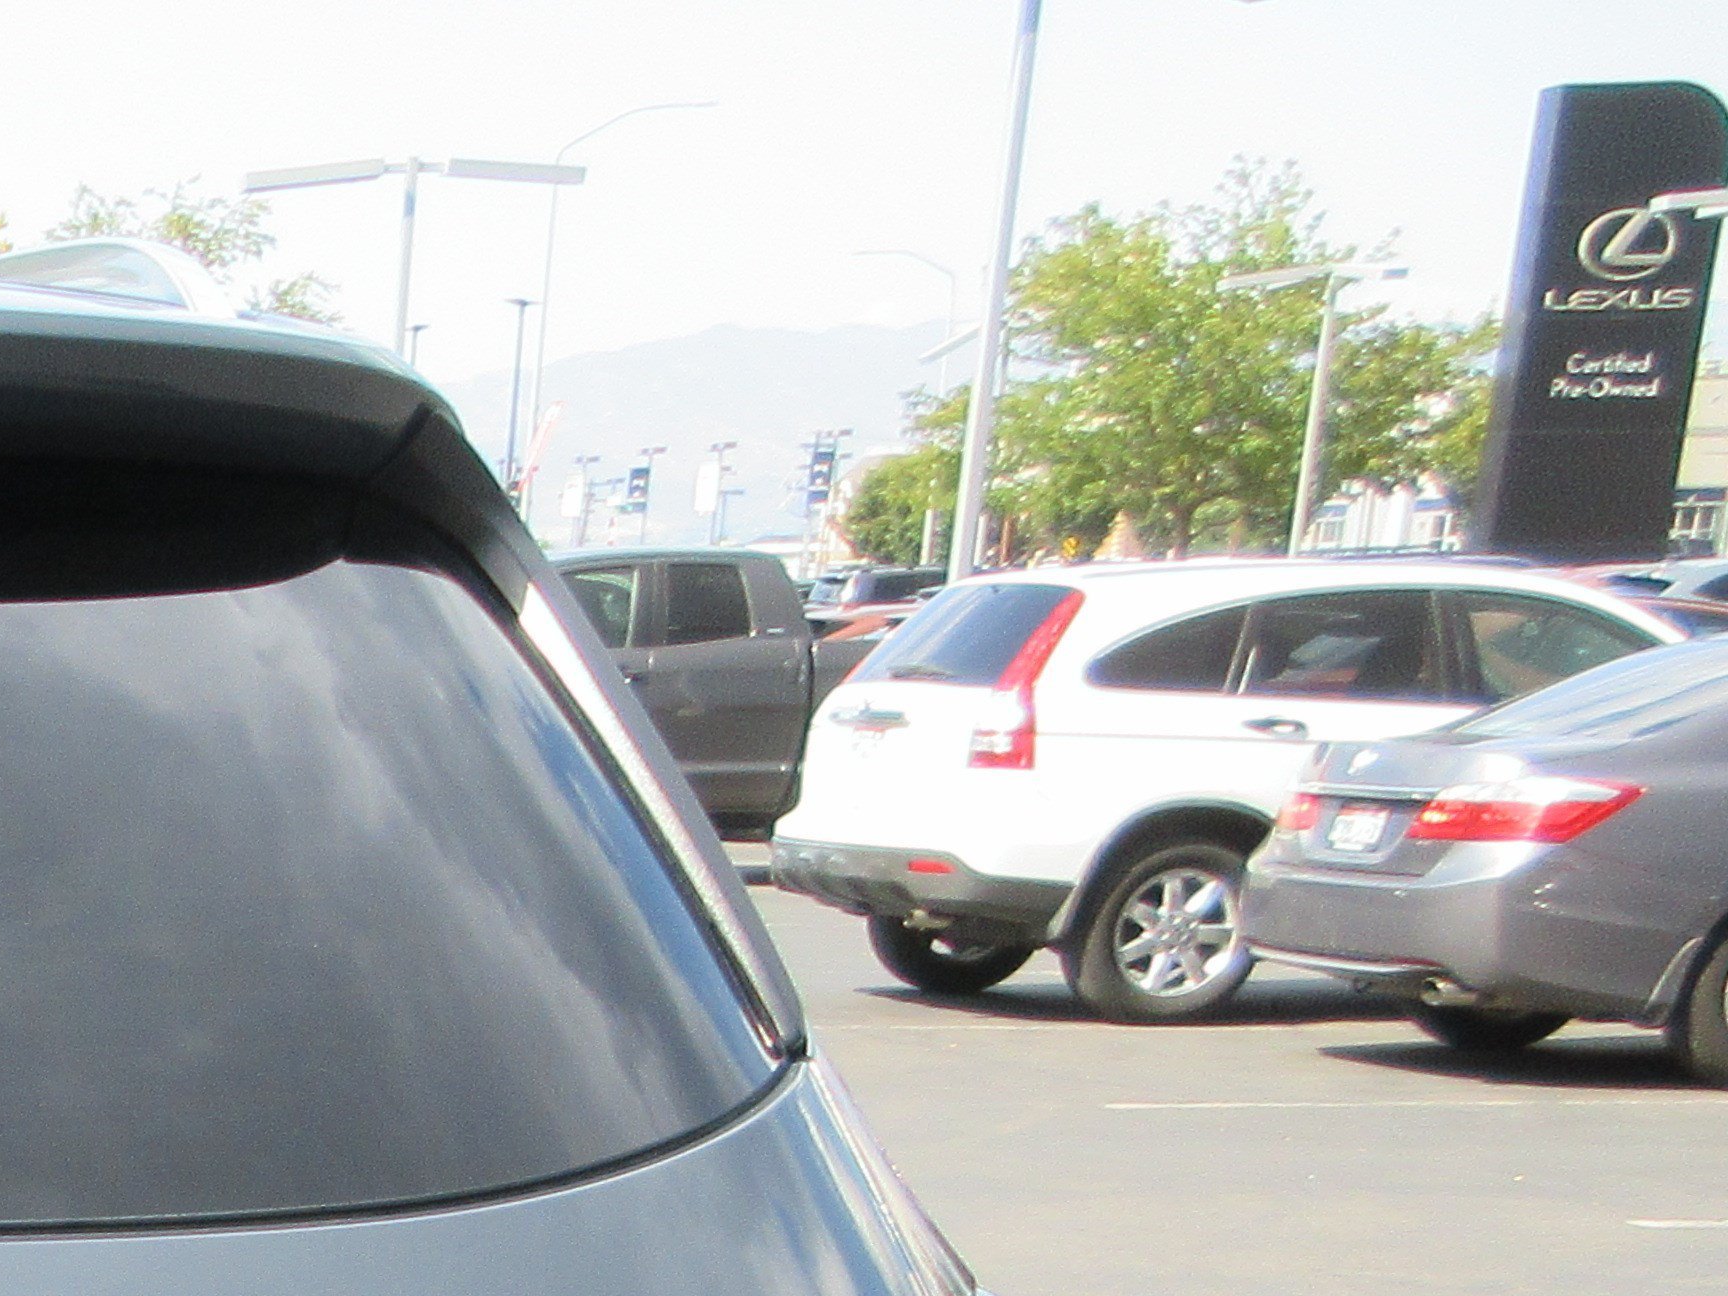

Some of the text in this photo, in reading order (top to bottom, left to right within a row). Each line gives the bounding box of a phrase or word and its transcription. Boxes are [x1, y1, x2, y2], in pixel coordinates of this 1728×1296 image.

[1544, 288, 1694, 311] LEXUS
[1566, 350, 1653, 374] Certified
[1550, 376, 1660, 398] Pre-Owned
